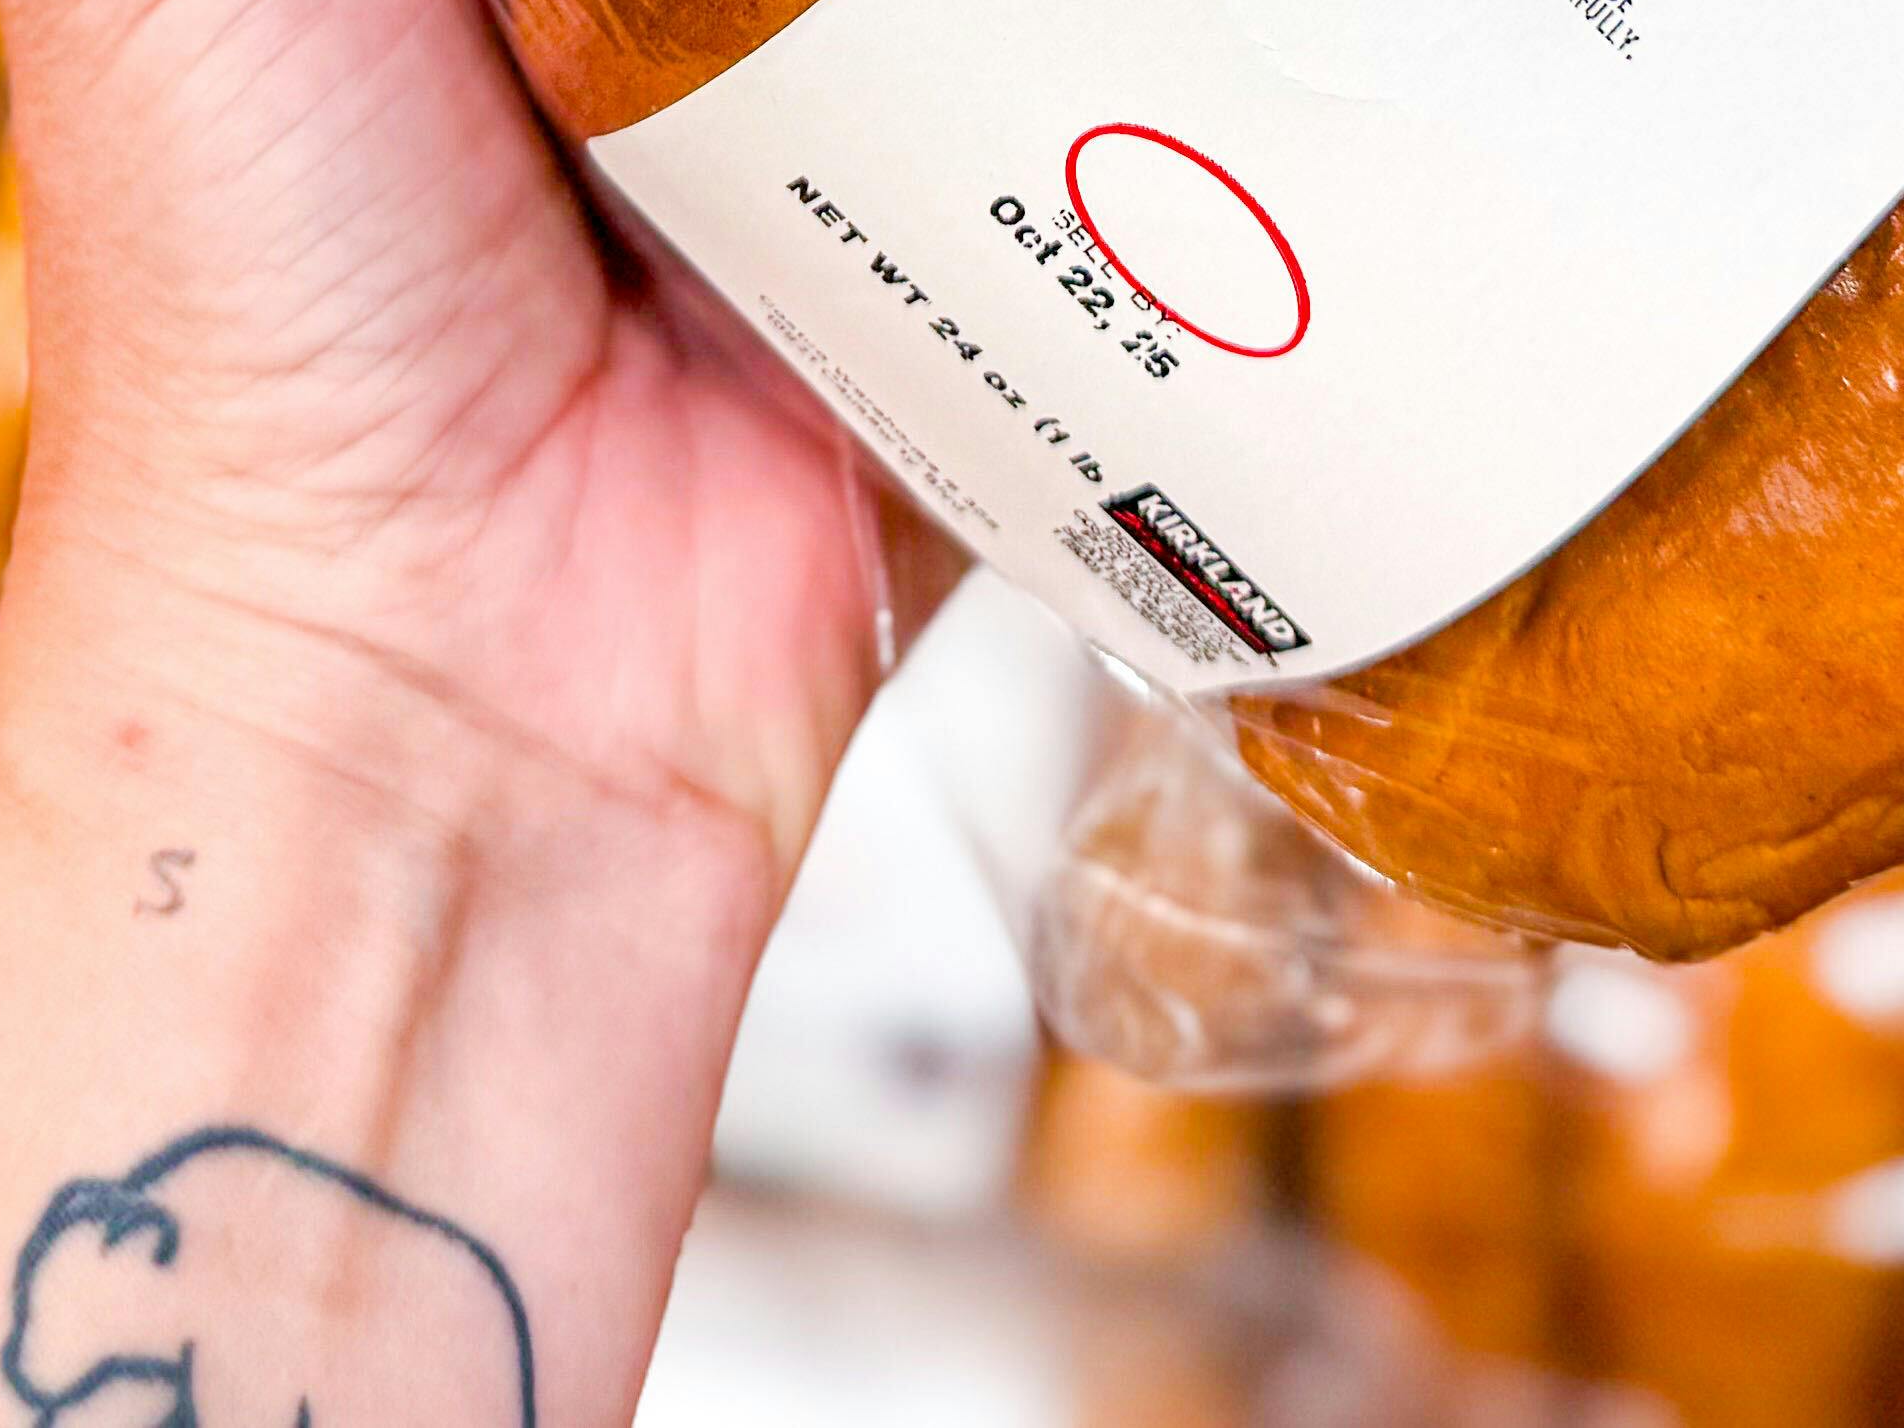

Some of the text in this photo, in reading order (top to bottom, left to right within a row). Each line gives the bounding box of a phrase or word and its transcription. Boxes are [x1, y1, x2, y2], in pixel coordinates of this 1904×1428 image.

[990, 195, 1063, 265] Oct
[1057, 264, 1115, 330] 22,
[1052, 209, 1117, 279] SELL
[786, 175, 869, 246] NET
[870, 251, 930, 307] WT
[929, 316, 983, 362] 24
[983, 370, 1027, 409] oz
[1069, 451, 1103, 483] lb
[1137, 493, 1297, 649] KIRKLAND
